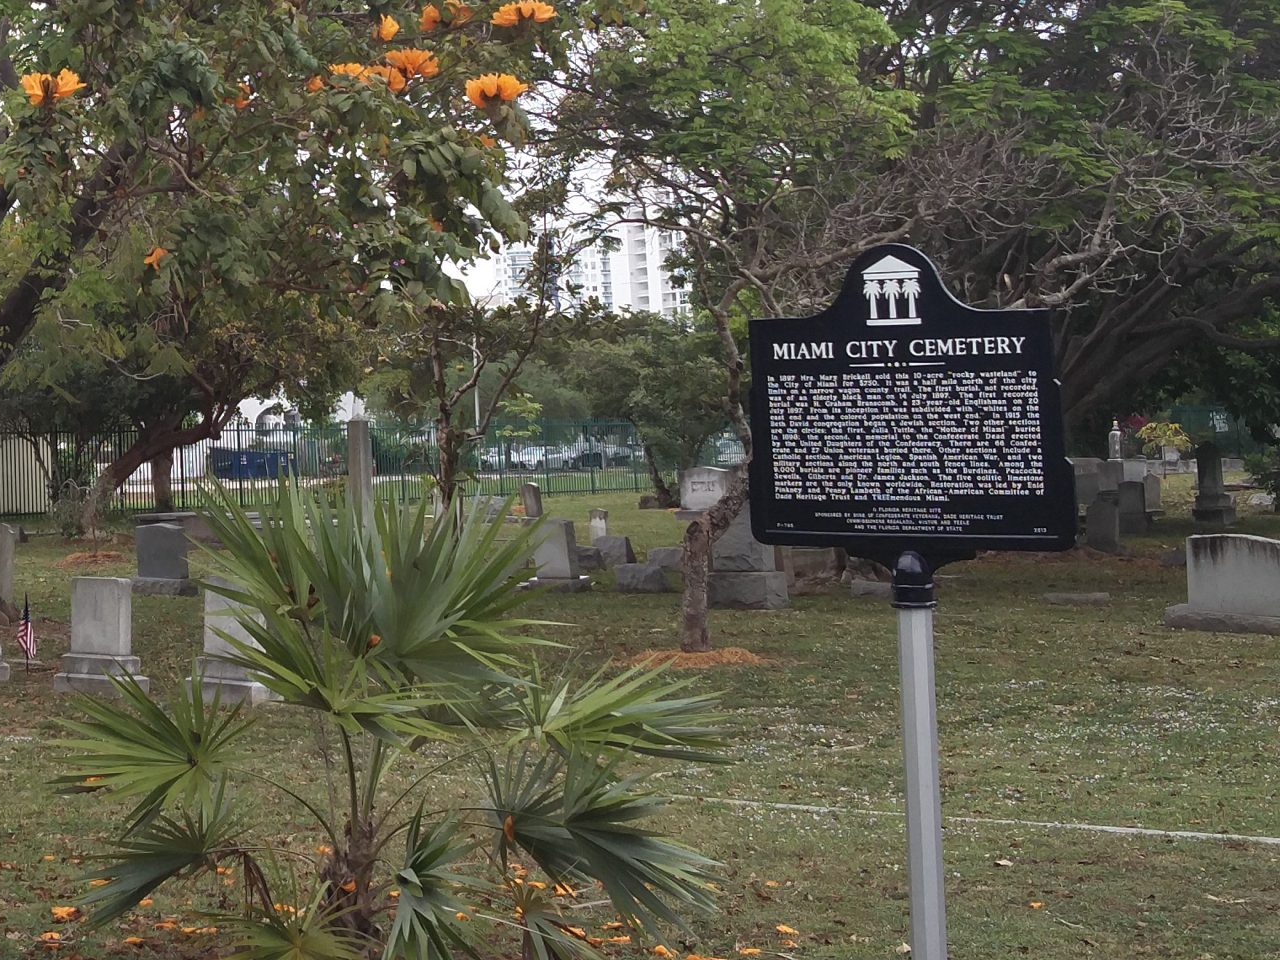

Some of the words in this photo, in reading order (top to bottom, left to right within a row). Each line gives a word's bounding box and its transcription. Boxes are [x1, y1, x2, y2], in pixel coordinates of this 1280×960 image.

[772, 342, 834, 360] MIAMI
[846, 340, 898, 358] CITY
[909, 336, 1026, 356] CEMETERY
